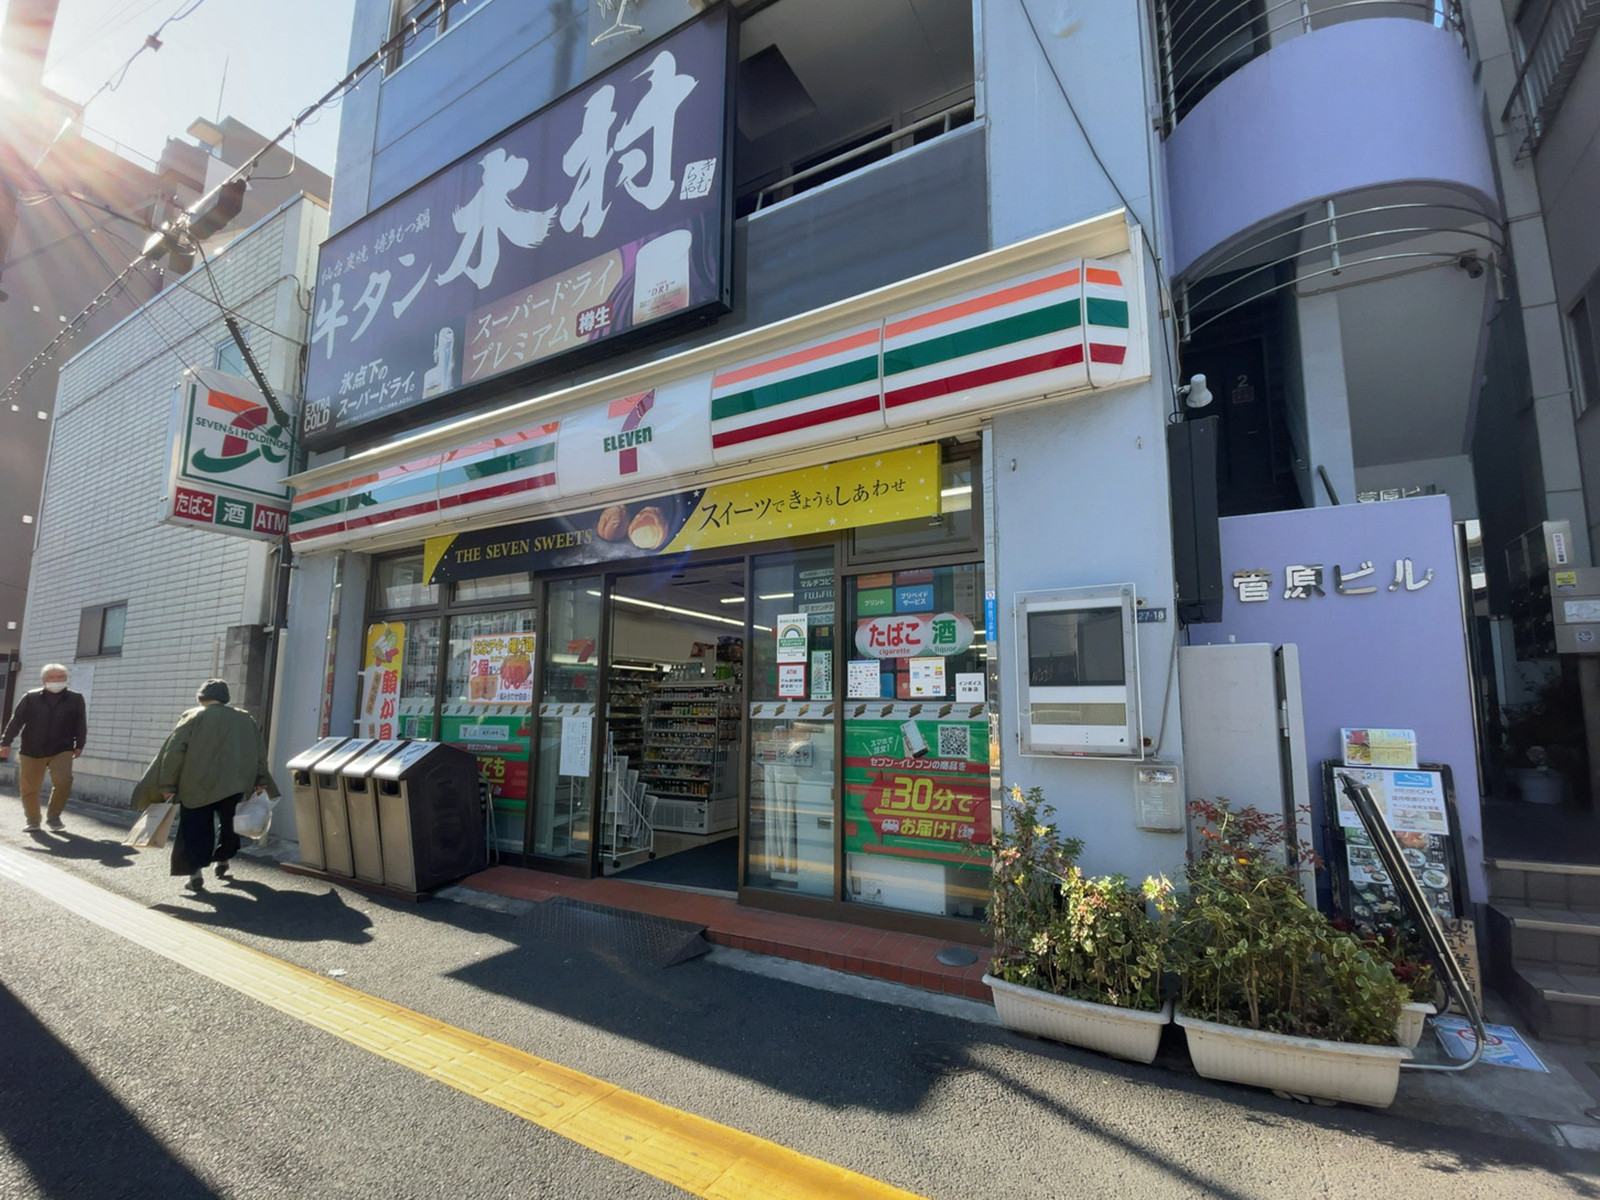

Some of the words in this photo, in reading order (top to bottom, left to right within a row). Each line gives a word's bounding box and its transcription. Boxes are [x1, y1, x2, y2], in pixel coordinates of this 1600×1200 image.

[435, 50, 699, 289] 木村
[312, 253, 432, 360] 牛タン
[470, 259, 615, 345] スーパードライ
[579, 304, 611, 333] 樽生
[470, 316, 570, 379] プレミアム
[339, 358, 388, 396] 氷点下の
[1237, 374, 1249, 388] 2
[305, 395, 331, 416] EXTRA
[304, 409, 331, 432] COLD
[175, 492, 213, 518] たばこ
[222, 501, 247, 524] 酒
[256, 510, 288, 533] ATM
[455, 547, 482, 564] THE
[485, 538, 531, 560] SEVEN
[534, 528, 593, 552] SWEETS
[1232, 557, 1435, 602] 菅原ビル
[869, 621, 921, 648] たばこ
[931, 619, 957, 645] 酒
[878, 647, 911, 656] cigarette
[934, 645, 957, 653] liquor
